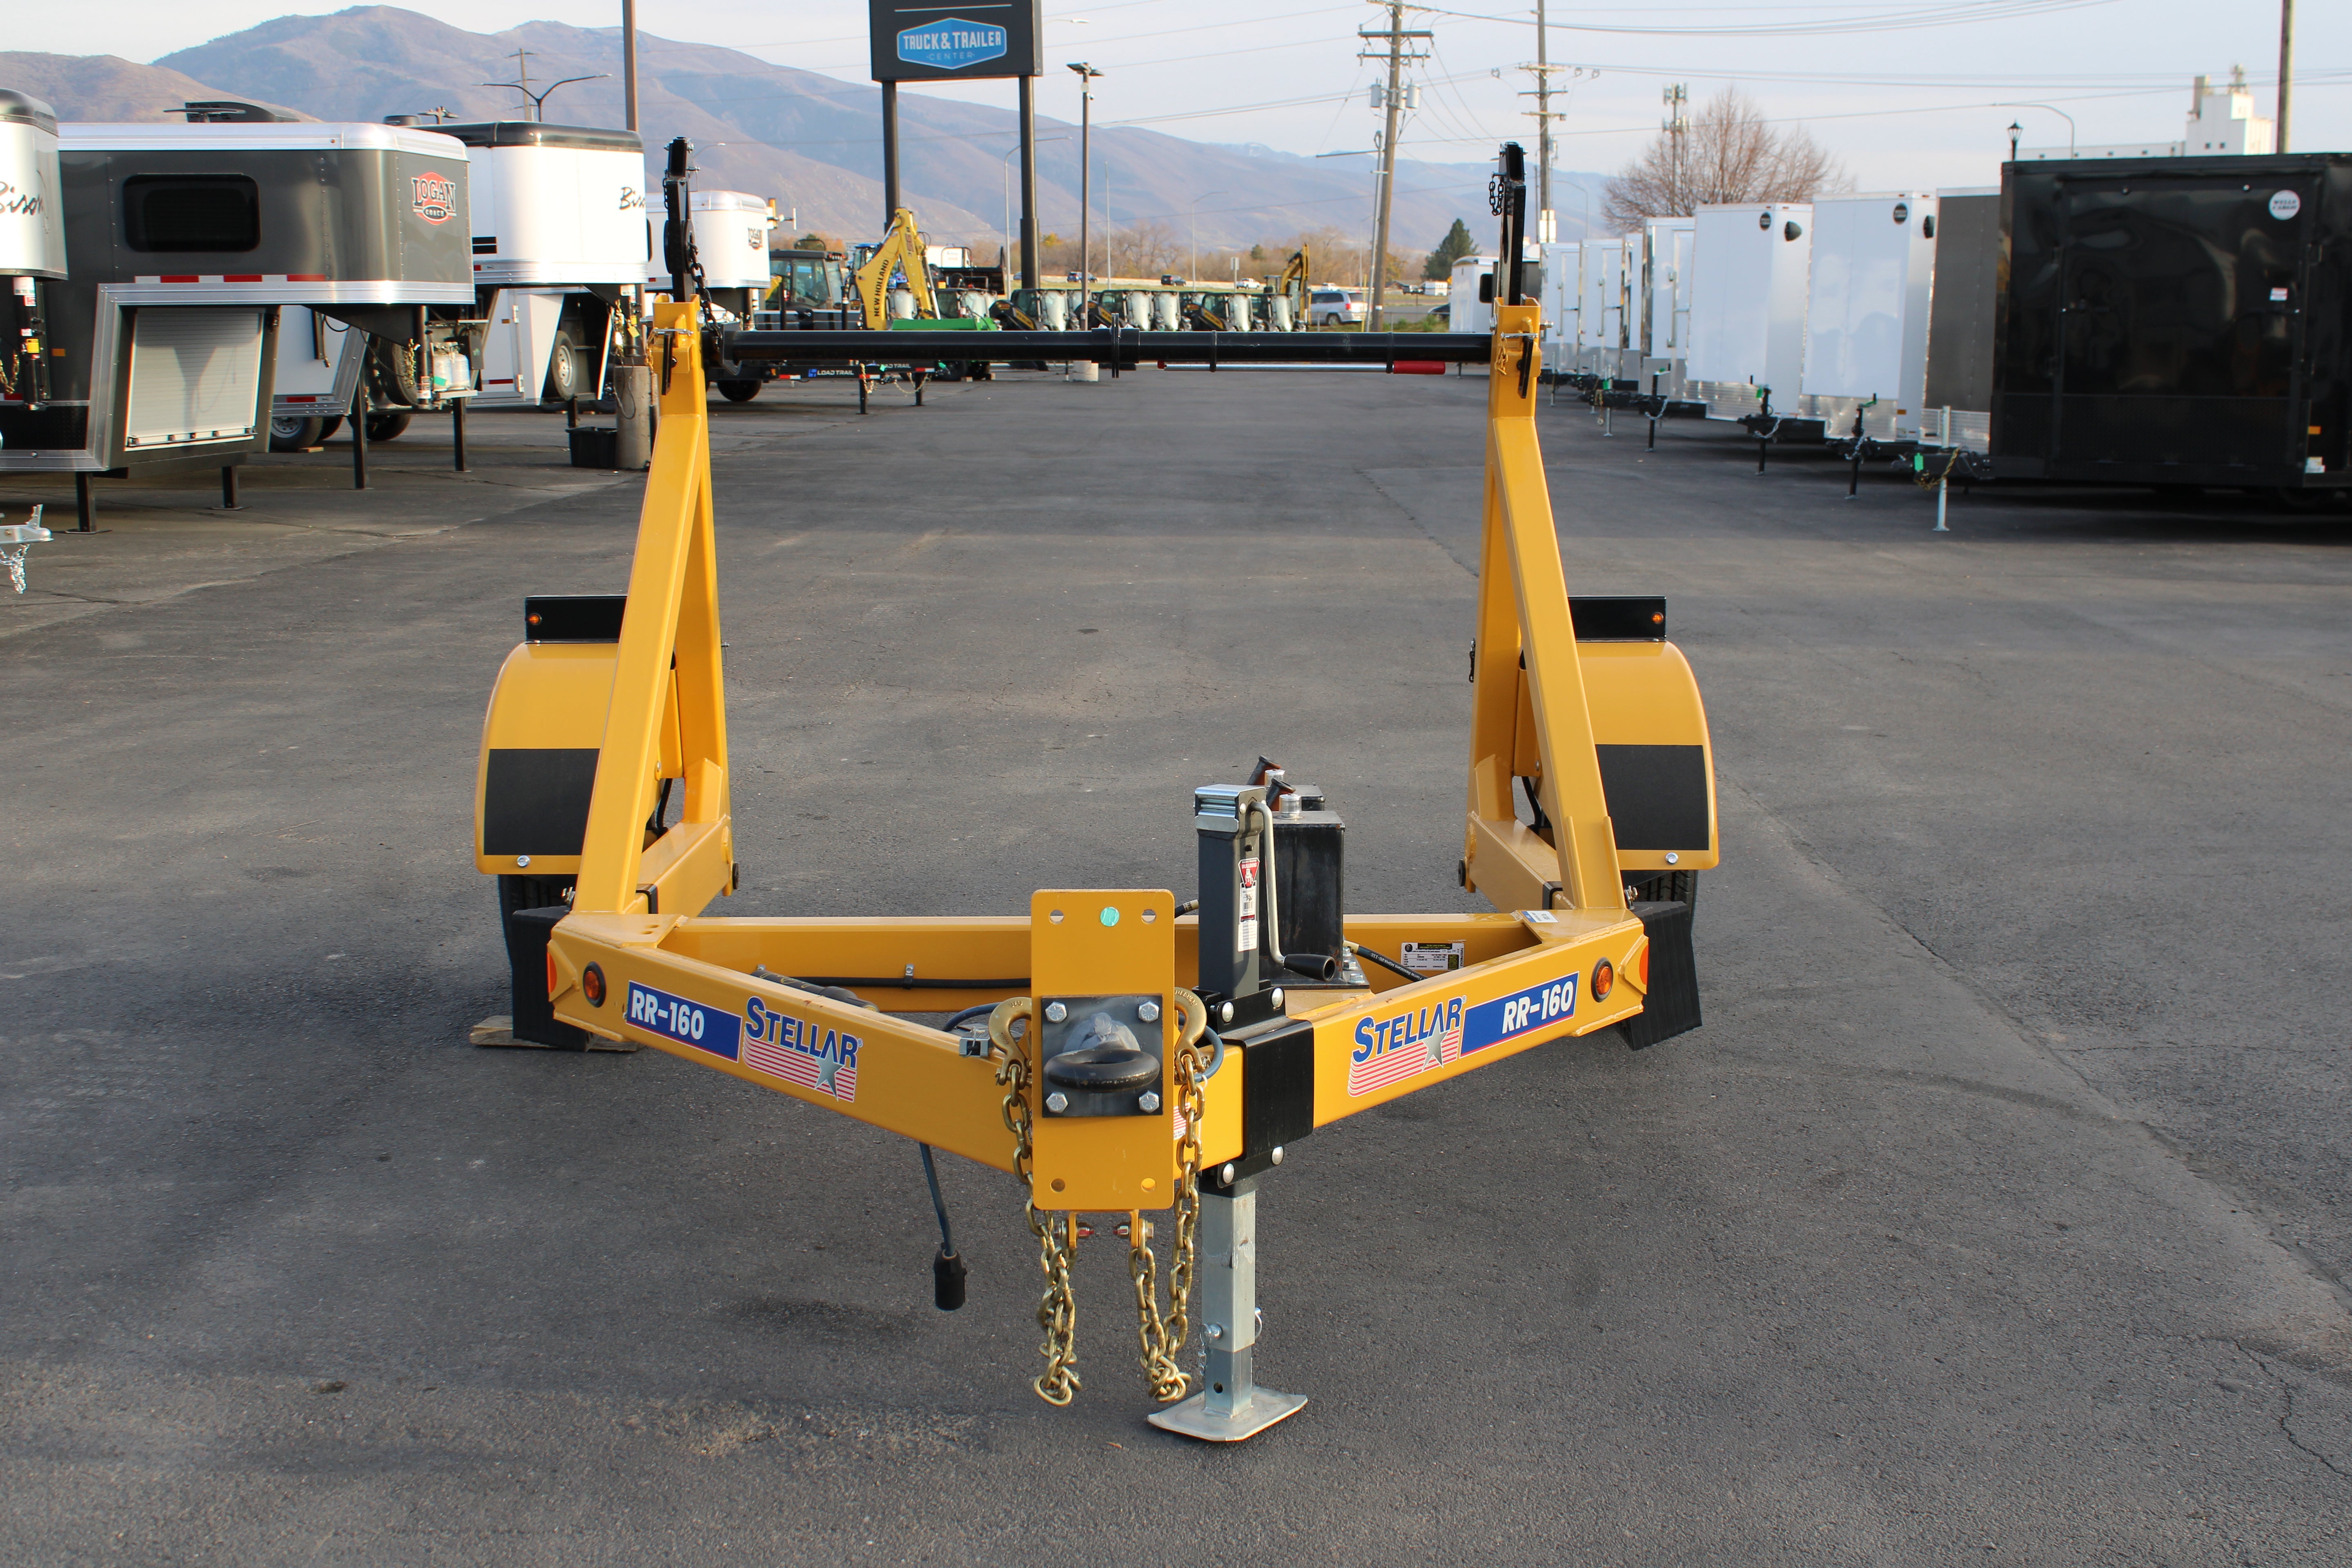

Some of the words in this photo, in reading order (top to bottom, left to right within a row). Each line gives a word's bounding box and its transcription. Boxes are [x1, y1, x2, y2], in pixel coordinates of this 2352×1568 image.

[903, 33, 939, 50] TRUCK
[940, 32, 951, 49] &
[952, 31, 1002, 49] TRAILER
[928, 51, 973, 60] CENTER
[411, 177, 456, 212] LOGAN
[875, 259, 889, 296] HOLLAND
[1394, 964, 1411, 975] Resistant
[631, 989, 704, 1040] RR-160
[1502, 981, 1573, 1034] RR-160
[745, 996, 858, 1070] STELLAR
[1352, 996, 1463, 1063] STELLAR
